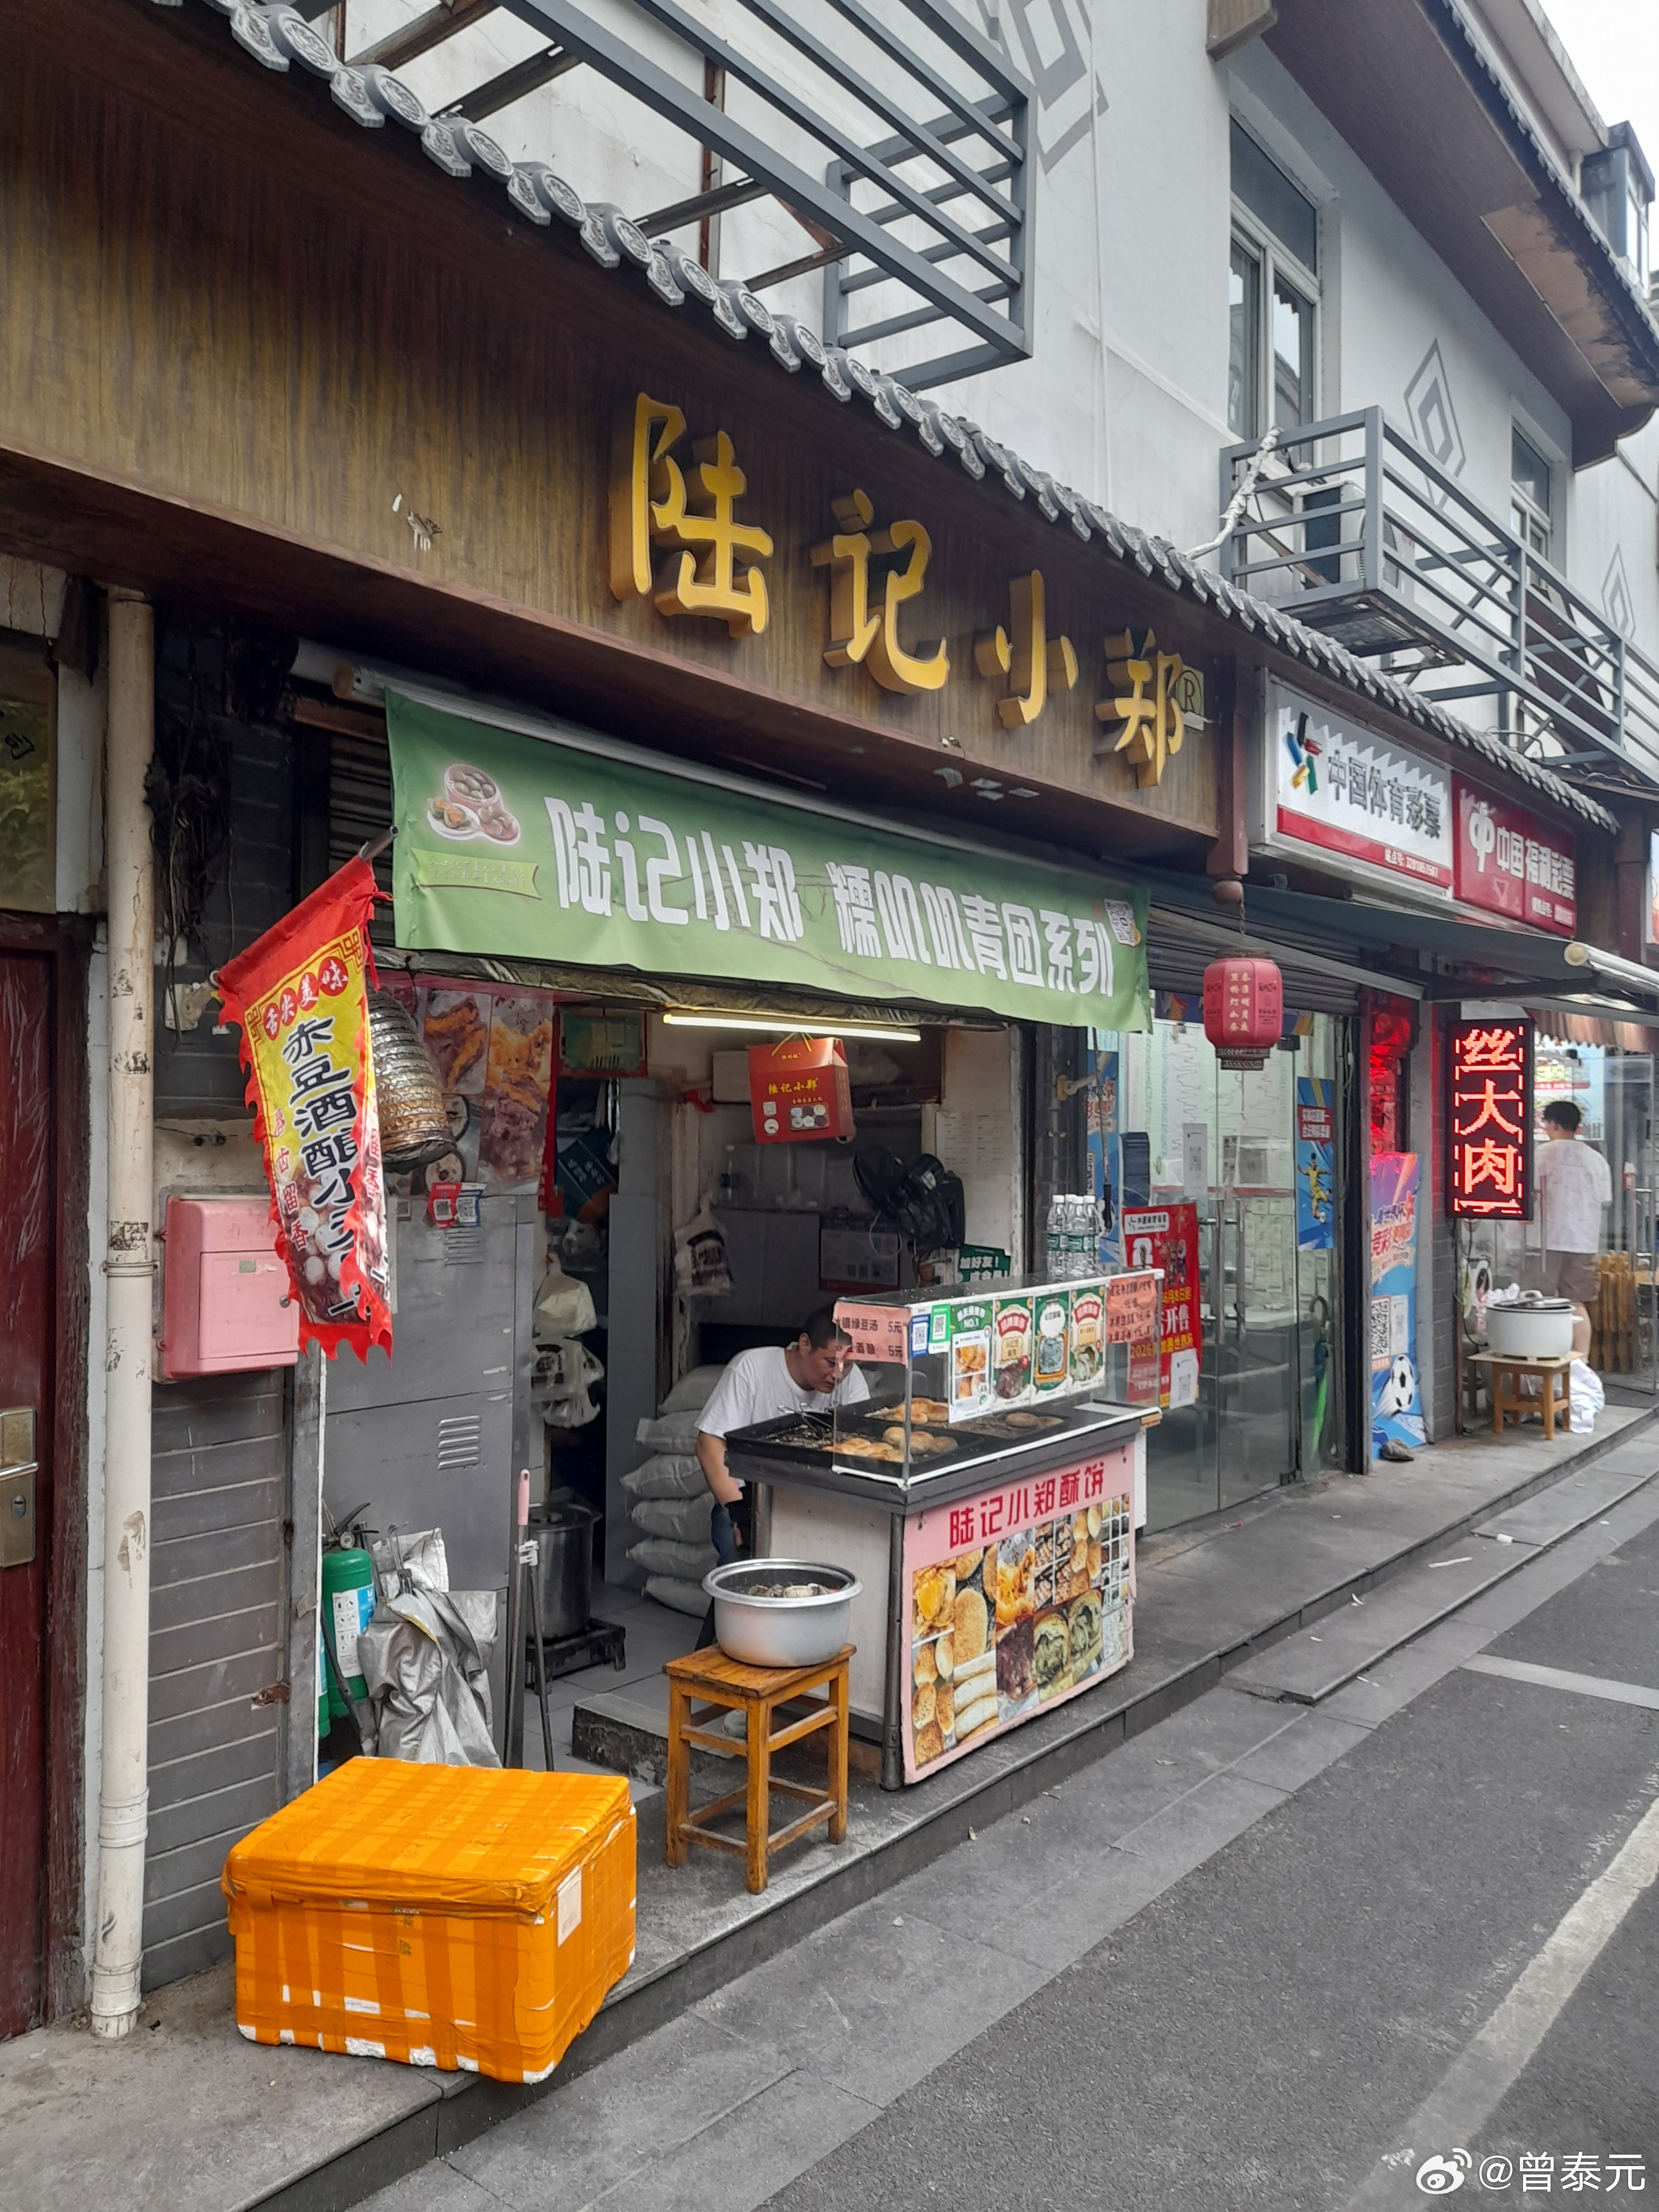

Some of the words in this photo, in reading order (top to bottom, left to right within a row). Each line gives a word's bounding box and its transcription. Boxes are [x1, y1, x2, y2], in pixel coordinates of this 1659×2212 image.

[632, 392, 1184, 787] 陆记小郑
[1328, 749, 1441, 839] 中国体育彩票
[544, 796, 804, 942] 陆记小郑
[825, 861, 1114, 998] 糯叽叽青团系列
[1496, 826, 1574, 901] 中国福利彩票
[265, 959, 348, 1036] 舌尖美味
[1459, 1027, 1522, 1214] 丝大肉
[274, 1108, 309, 1252] 唇齿留香
[836, 1316, 878, 1332] 镇绿豆汤
[949, 1462, 1104, 1549] 陆记小郑酥饼
